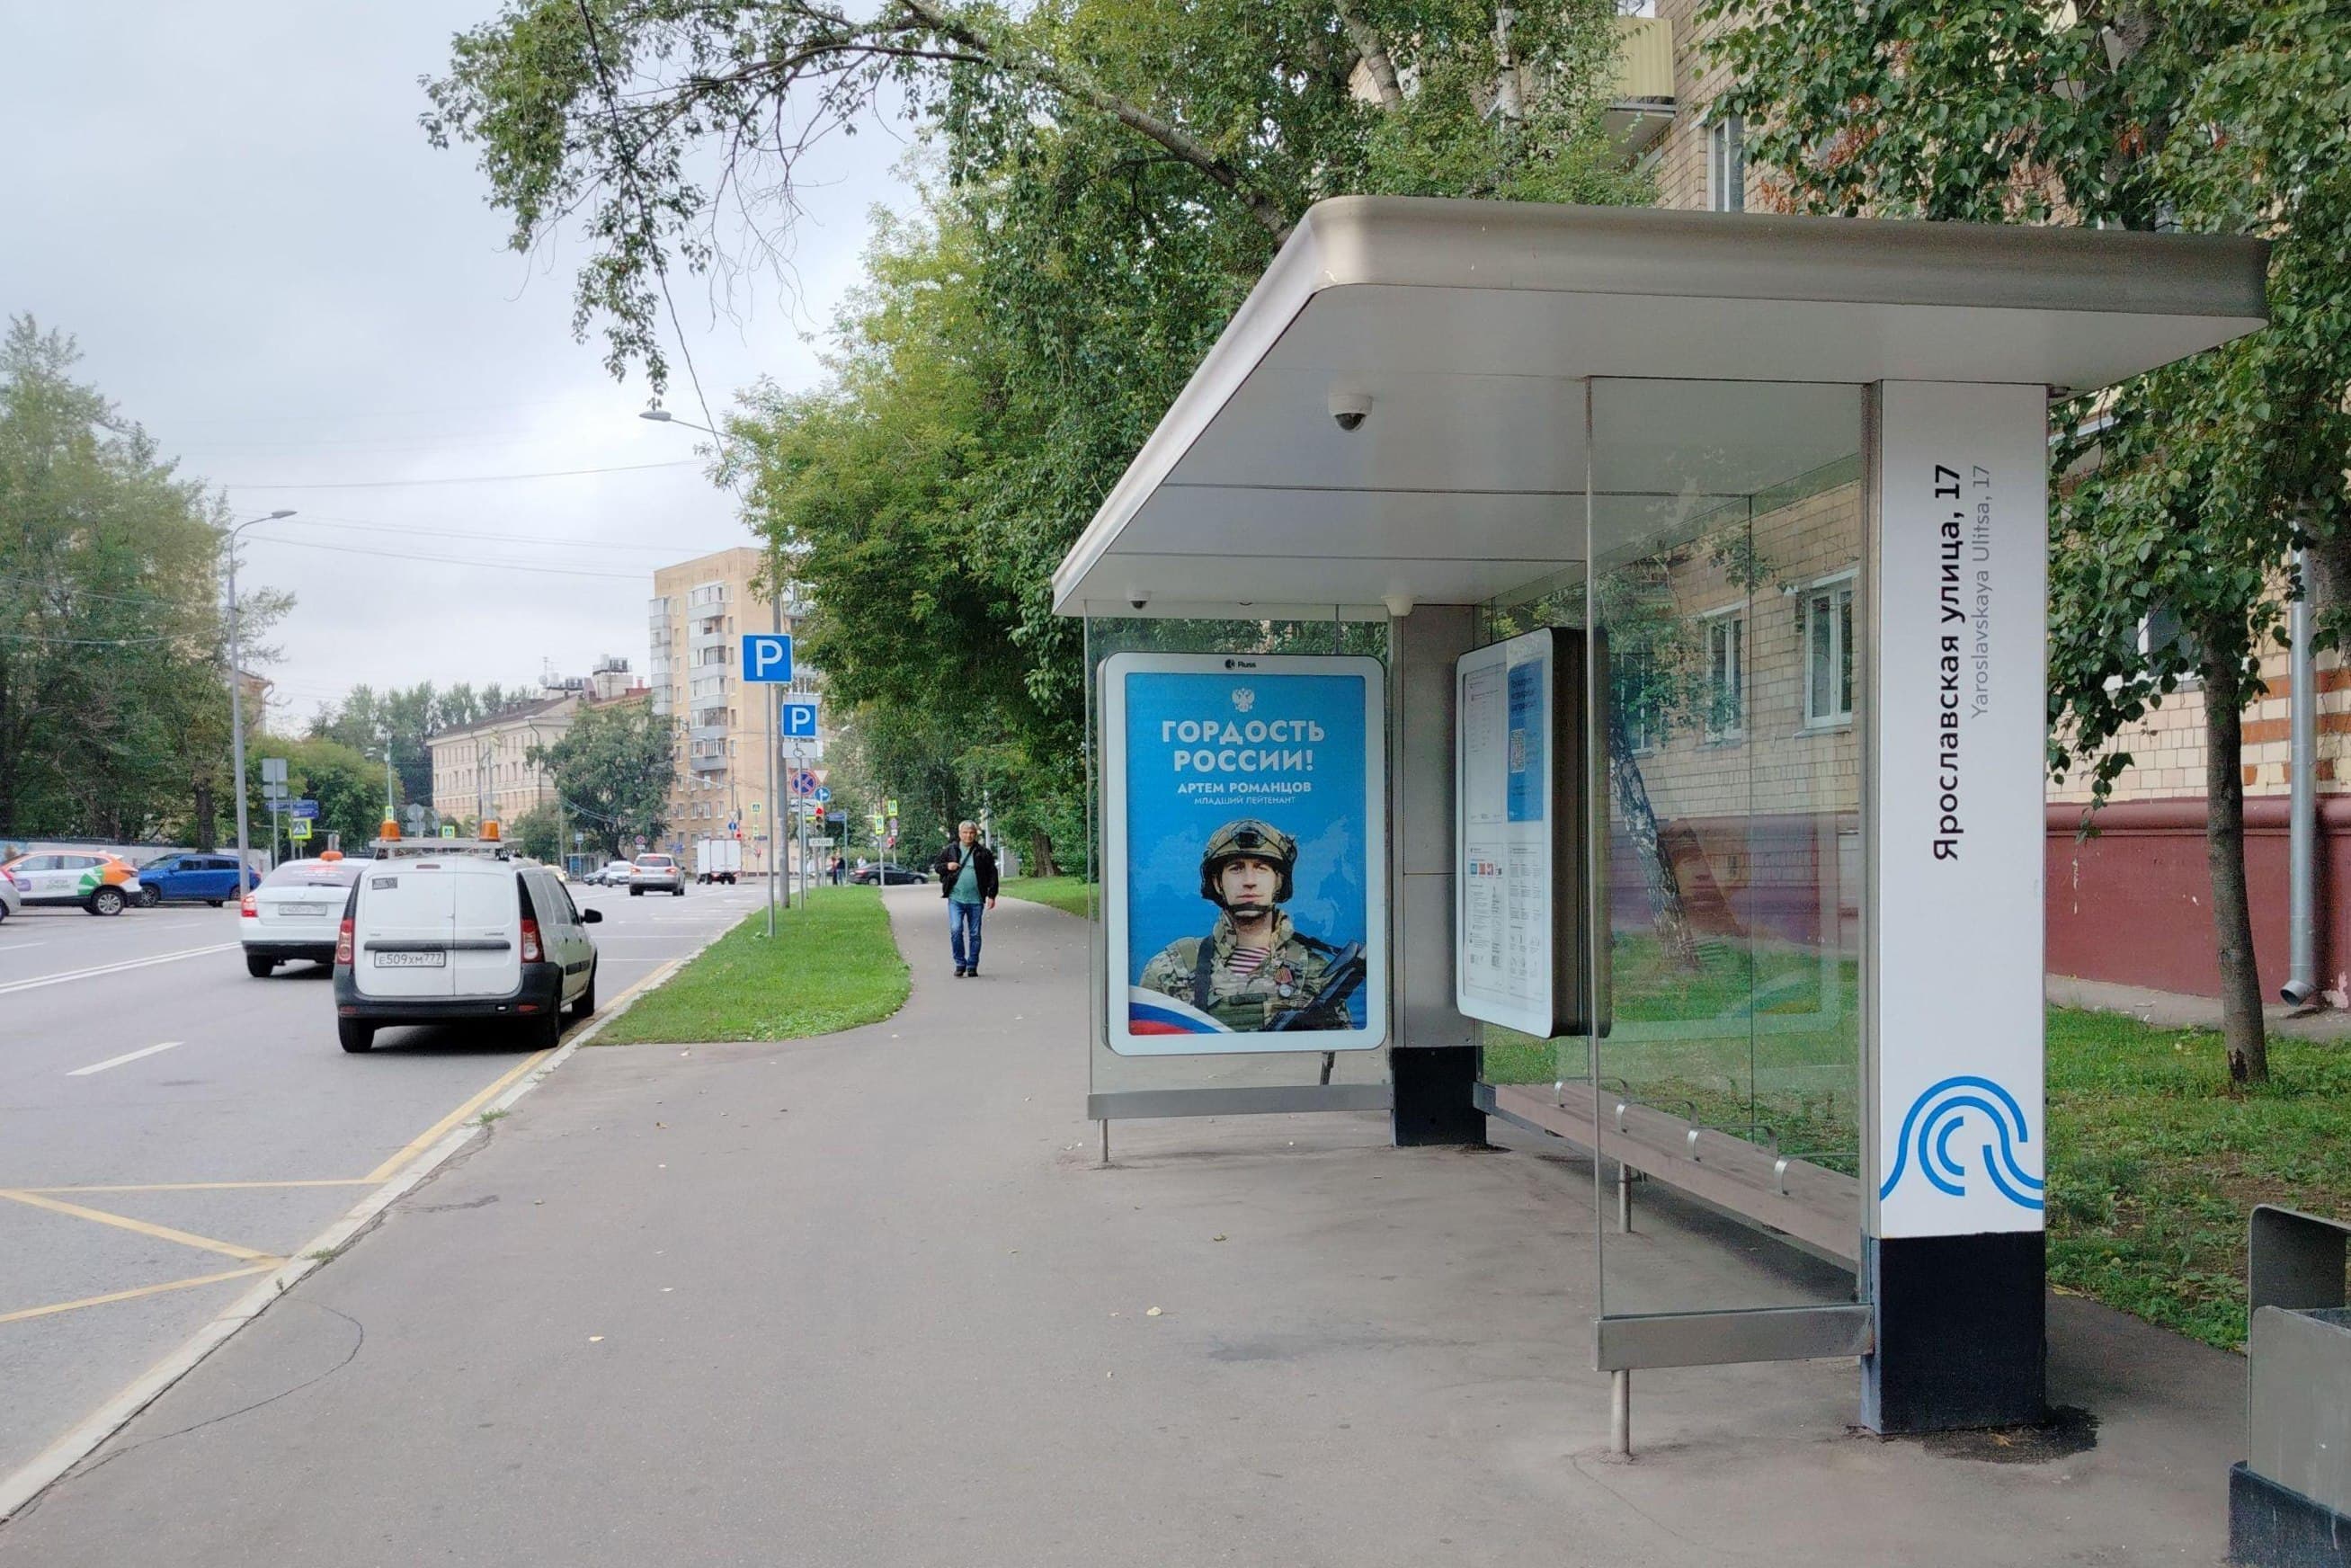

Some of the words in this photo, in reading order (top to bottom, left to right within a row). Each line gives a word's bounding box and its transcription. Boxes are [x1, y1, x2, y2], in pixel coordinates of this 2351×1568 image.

[1935, 464, 1960, 499] 17
[1973, 465, 1990, 488] 17
[1972, 495, 1993, 561] Ulitsa,
[1941, 512, 1966, 624] улица,
[755, 638, 784, 677] P
[1971, 570, 1993, 718] Yaroslavskaya
[1237, 660, 1257, 669] Russ
[791, 707, 811, 734] P
[1162, 719, 1325, 745] ГОРДОСТЬ
[1173, 749, 1314, 772] РОССИИ!
[1934, 635, 1964, 860] Ярославская
[1177, 782, 1224, 794] АРТЕМ
[1229, 781, 1313, 795] РОМАНЦОВ
[1194, 795, 1244, 806] МЛАДШИЙ
[1246, 795, 1296, 805] ЛЕЙТЕНАНТ
